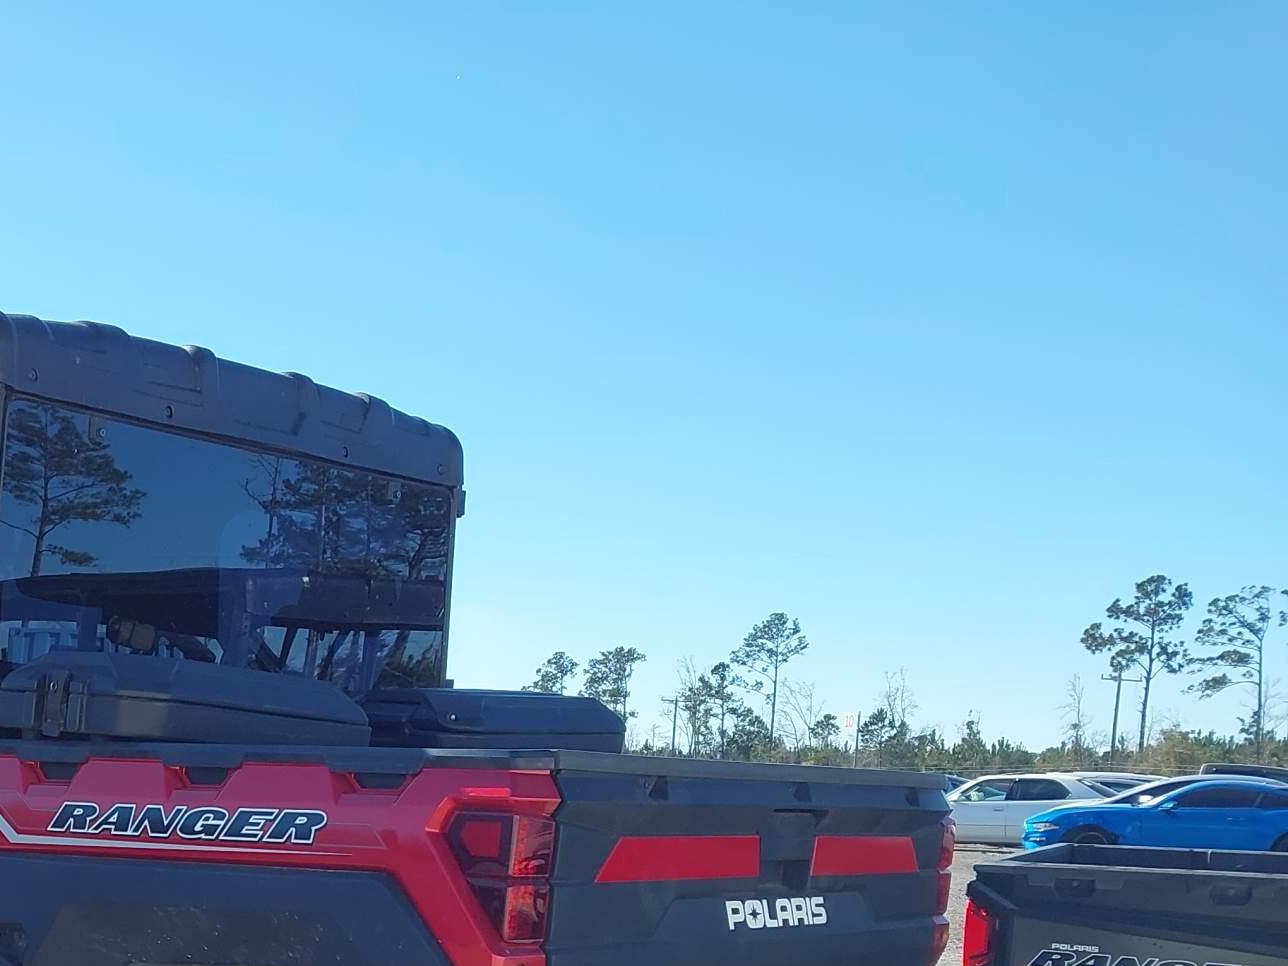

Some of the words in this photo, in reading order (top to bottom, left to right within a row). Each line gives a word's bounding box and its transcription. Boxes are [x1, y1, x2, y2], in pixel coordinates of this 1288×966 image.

[47, 802, 328, 845] RANGER
[725, 896, 829, 931] POLARIS
[1051, 943, 1100, 953] POLARIS
